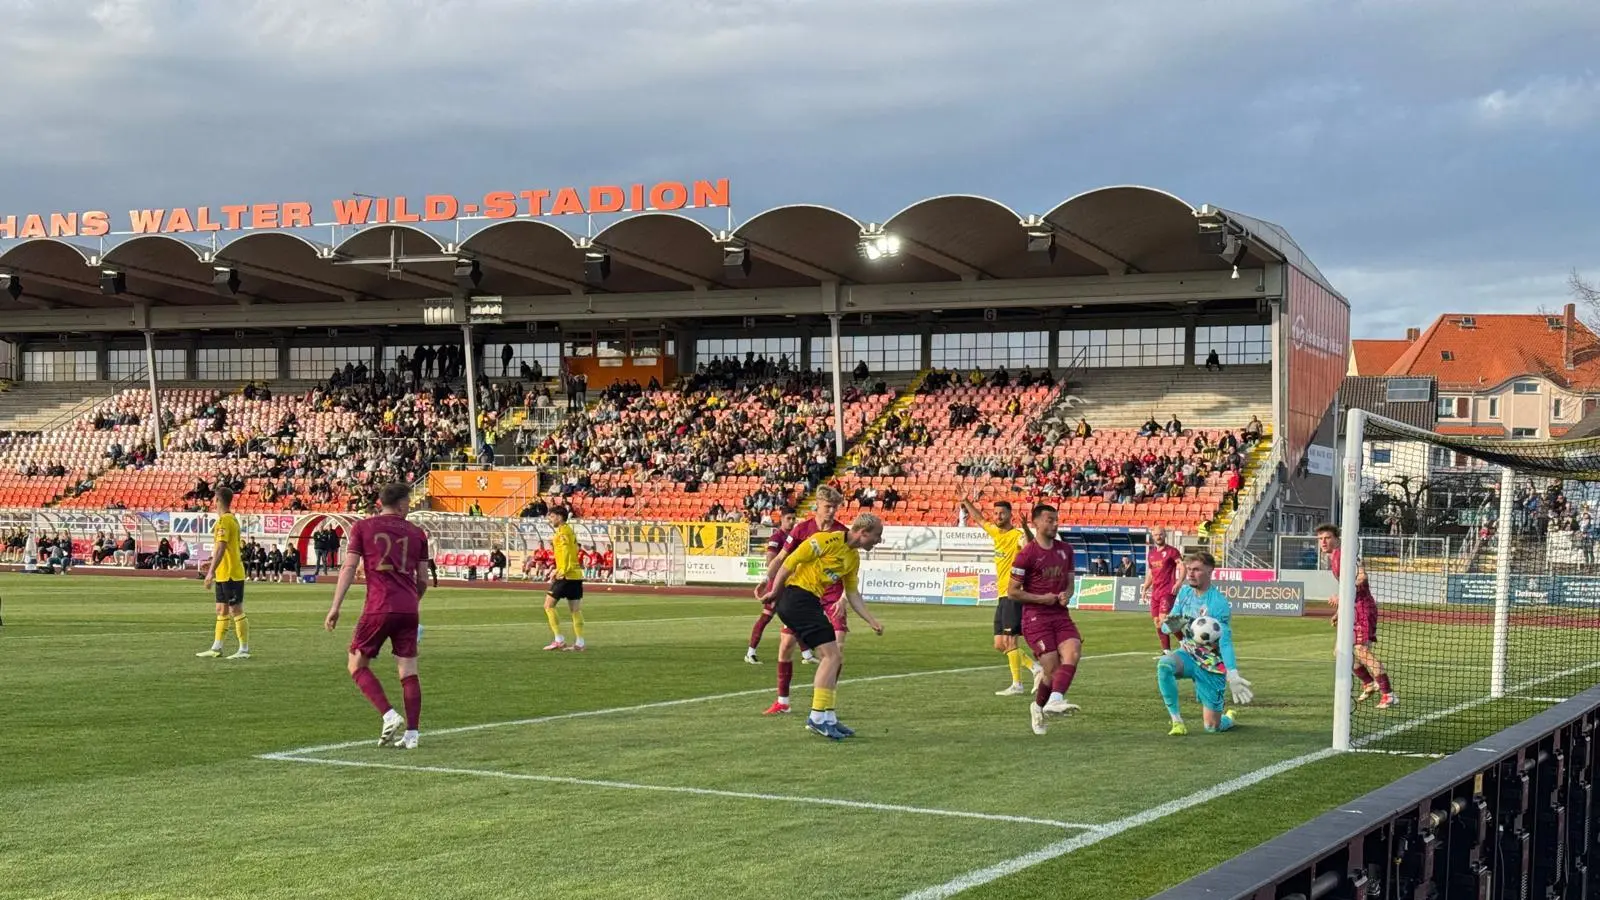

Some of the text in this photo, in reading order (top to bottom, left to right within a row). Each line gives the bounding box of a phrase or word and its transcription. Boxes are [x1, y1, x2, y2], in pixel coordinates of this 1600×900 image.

[0, 178, 731, 239] HANS WALTER WILD-STADION
[374, 532, 410, 575] 21
[905, 565, 990, 574] Fenster und Türen
[866, 576, 941, 589] elektro-gmbh
[1242, 602, 1271, 610] INTERIOR
[1275, 603, 1299, 611] DESIGN
